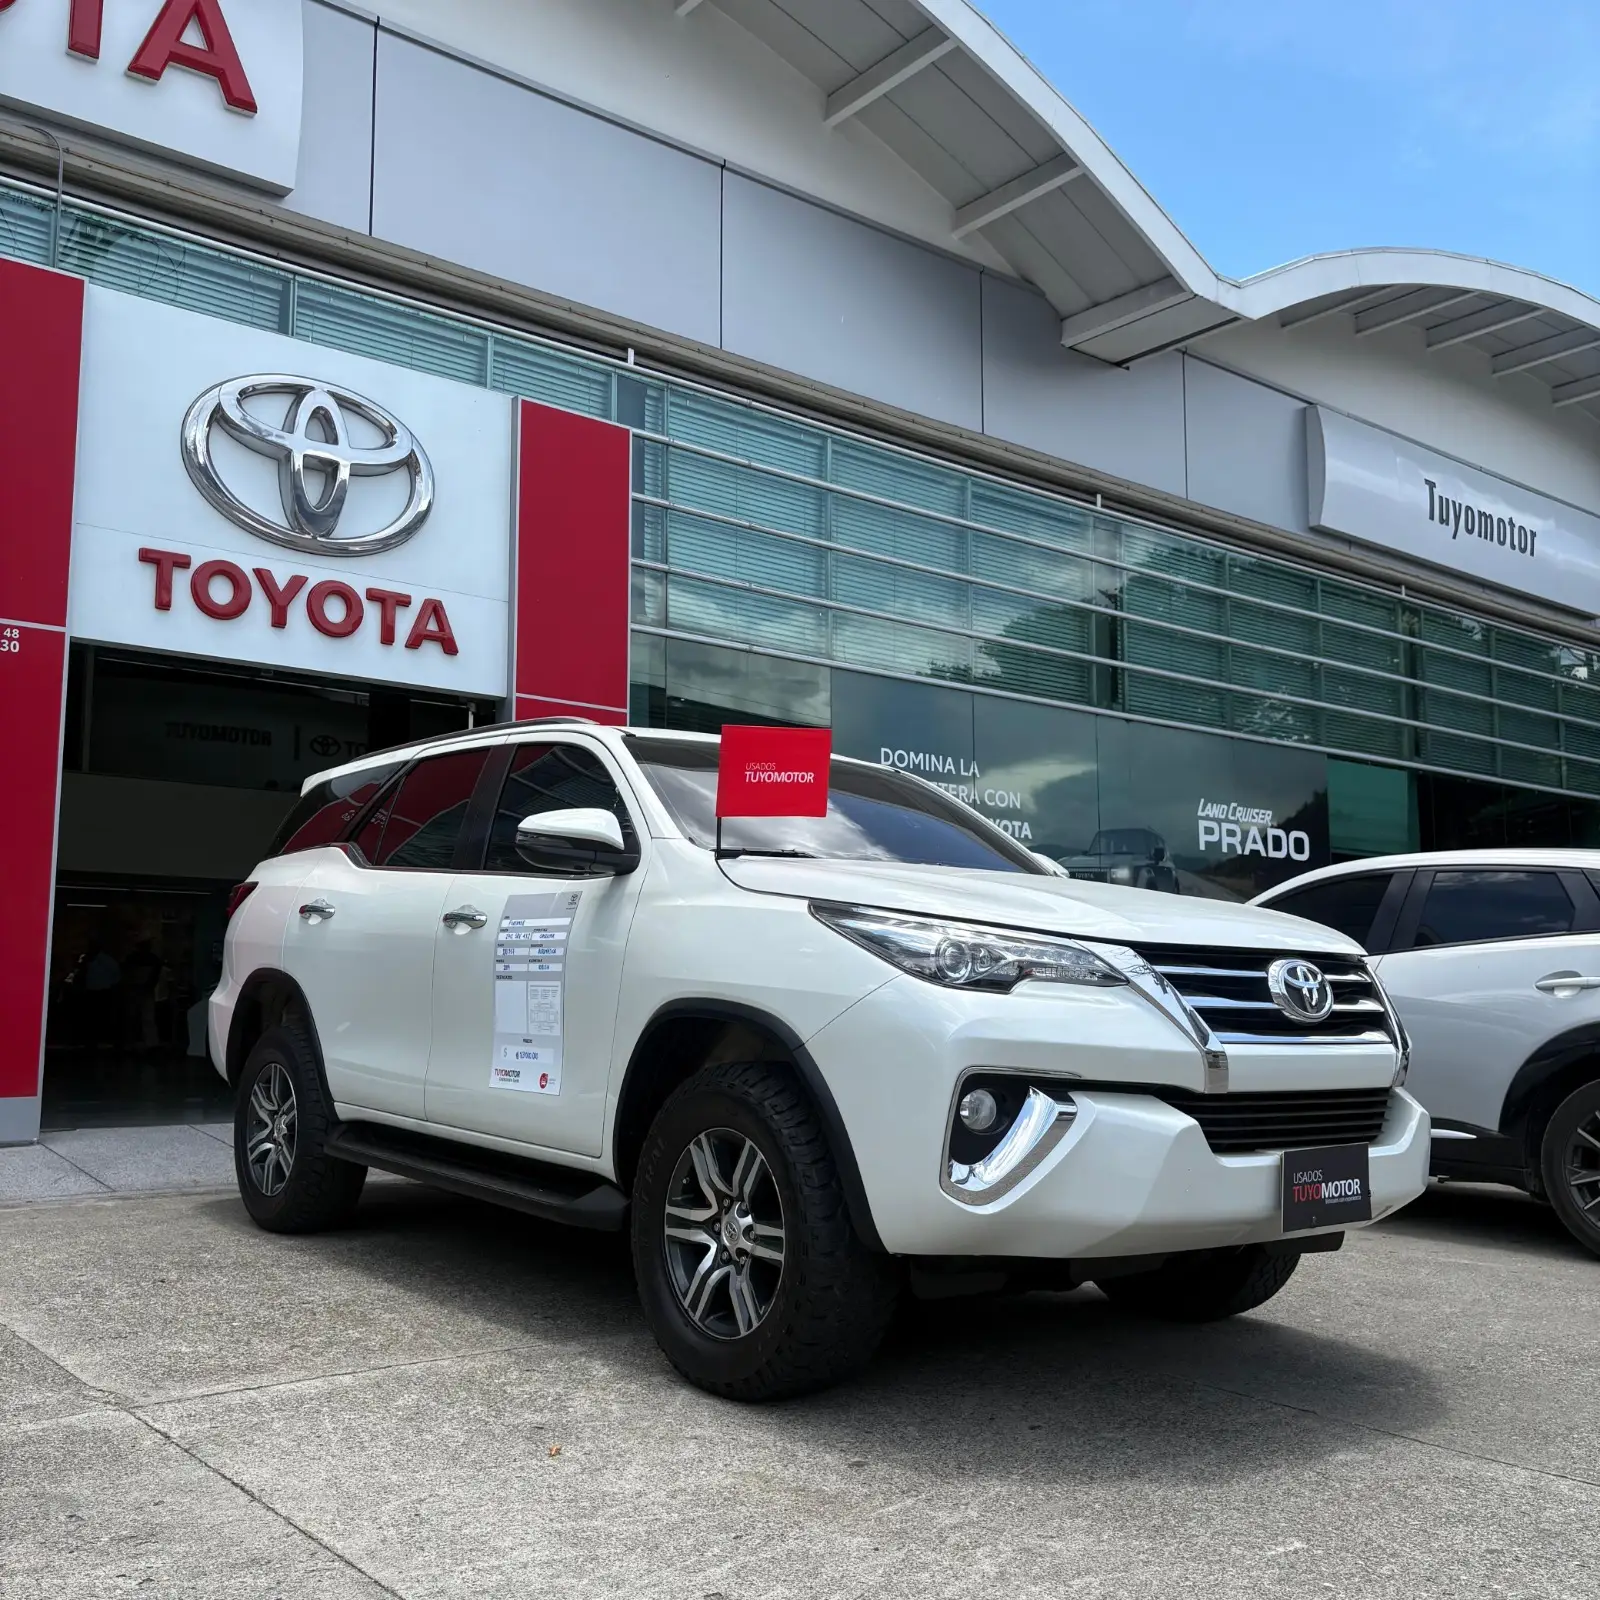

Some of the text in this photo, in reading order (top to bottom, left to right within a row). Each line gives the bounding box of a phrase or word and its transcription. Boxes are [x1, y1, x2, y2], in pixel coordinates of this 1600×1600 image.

[1424, 478, 1537, 557] Tuyomotor
[138, 547, 459, 656] TOYOTA
[3, 627, 20, 639] 48
[0, 639, 20, 653] 30
[164, 721, 272, 746] TUYOMOTOR
[745, 762, 777, 771] USADOS
[880, 747, 980, 778] DOMINA LA
[744, 771, 815, 783] TUYOMOTOR
[984, 789, 1021, 809] CON
[1198, 820, 1310, 862] PRADO
[1293, 1169, 1323, 1184] USADOS
[1292, 1178, 1361, 1203] TUYOMOTOR
